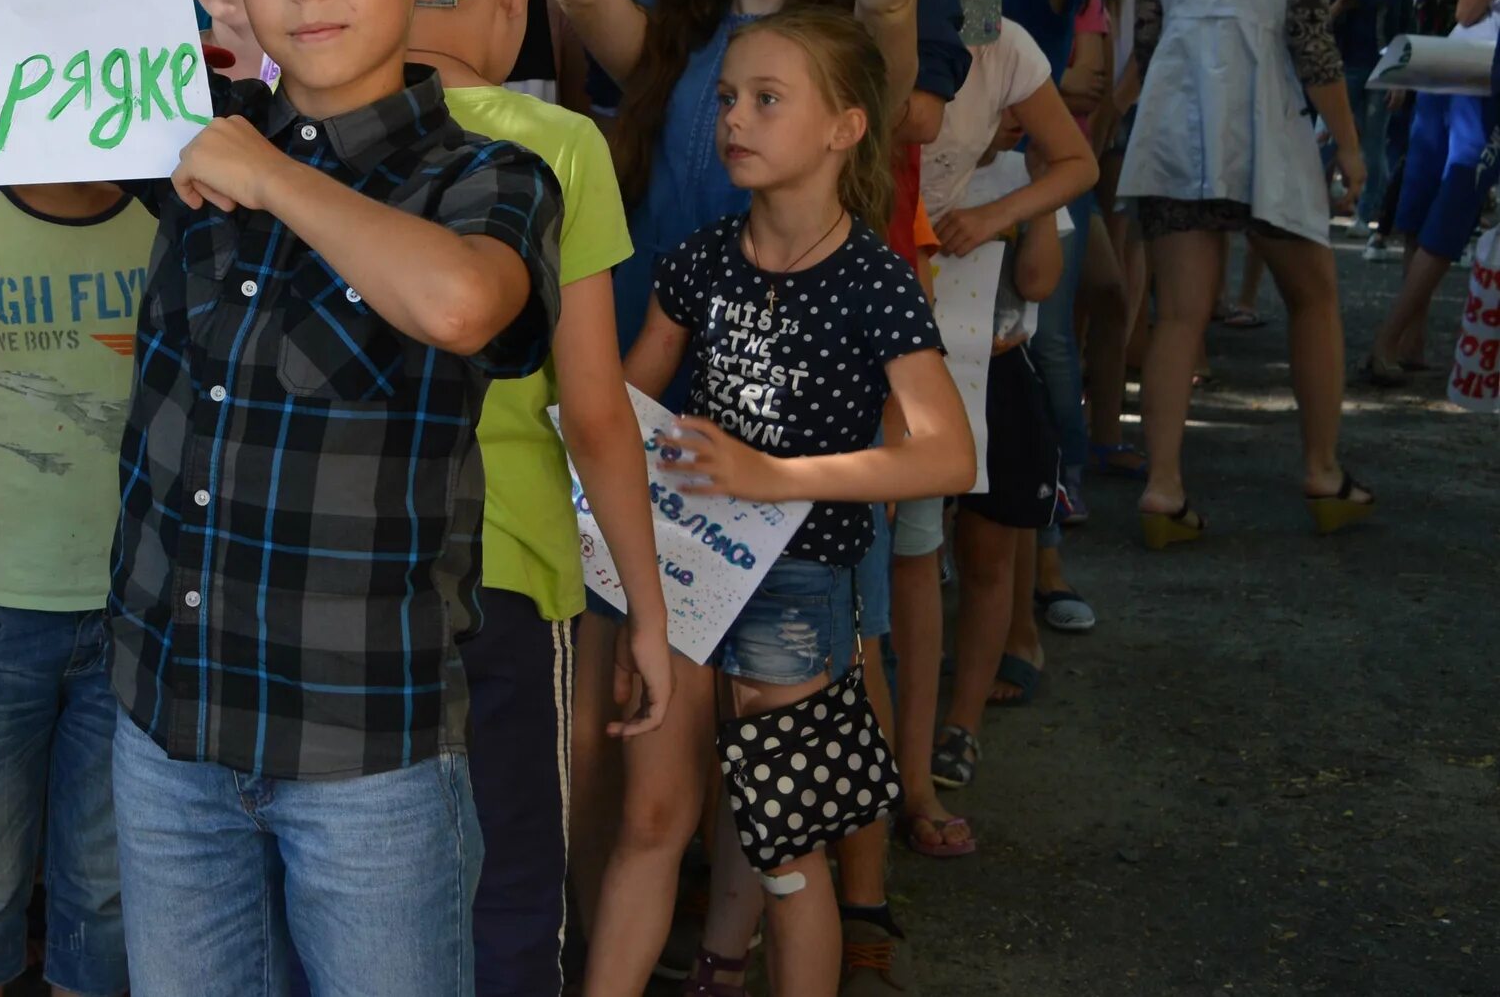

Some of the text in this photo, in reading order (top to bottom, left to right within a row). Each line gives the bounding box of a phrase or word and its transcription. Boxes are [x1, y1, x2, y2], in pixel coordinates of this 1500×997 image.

[710, 295, 800, 335] THIS IS
[25, 329, 80, 351] BOYS
[728, 328, 777, 358] THE
